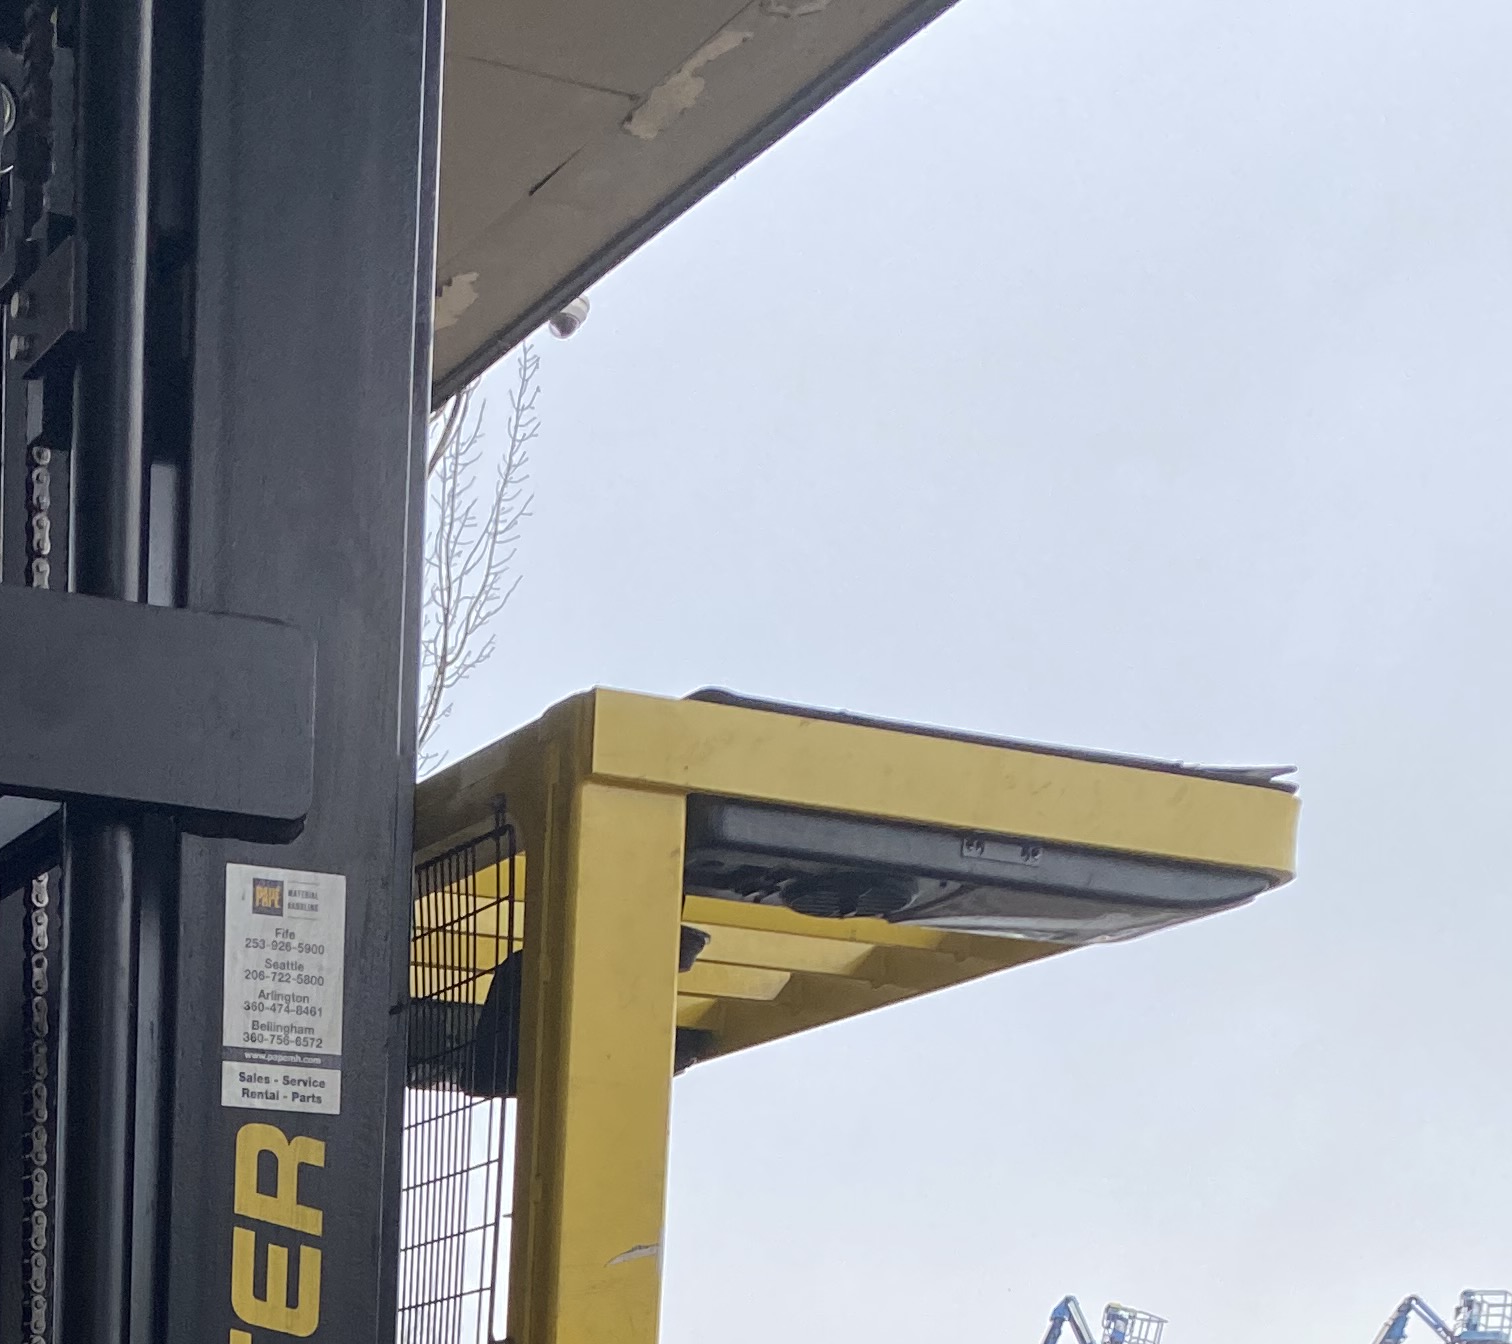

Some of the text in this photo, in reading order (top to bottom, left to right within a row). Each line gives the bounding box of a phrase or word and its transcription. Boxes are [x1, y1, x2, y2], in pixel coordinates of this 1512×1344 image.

[264, 958, 304, 971] Seattle
[258, 989, 309, 1004] Arlington
[251, 1020, 315, 1035] Bellingham
[239, 1072, 270, 1084] Sales
[282, 1075, 326, 1089] Service
[241, 1087, 280, 1101] Rental
[291, 1091, 322, 1104] Parts
